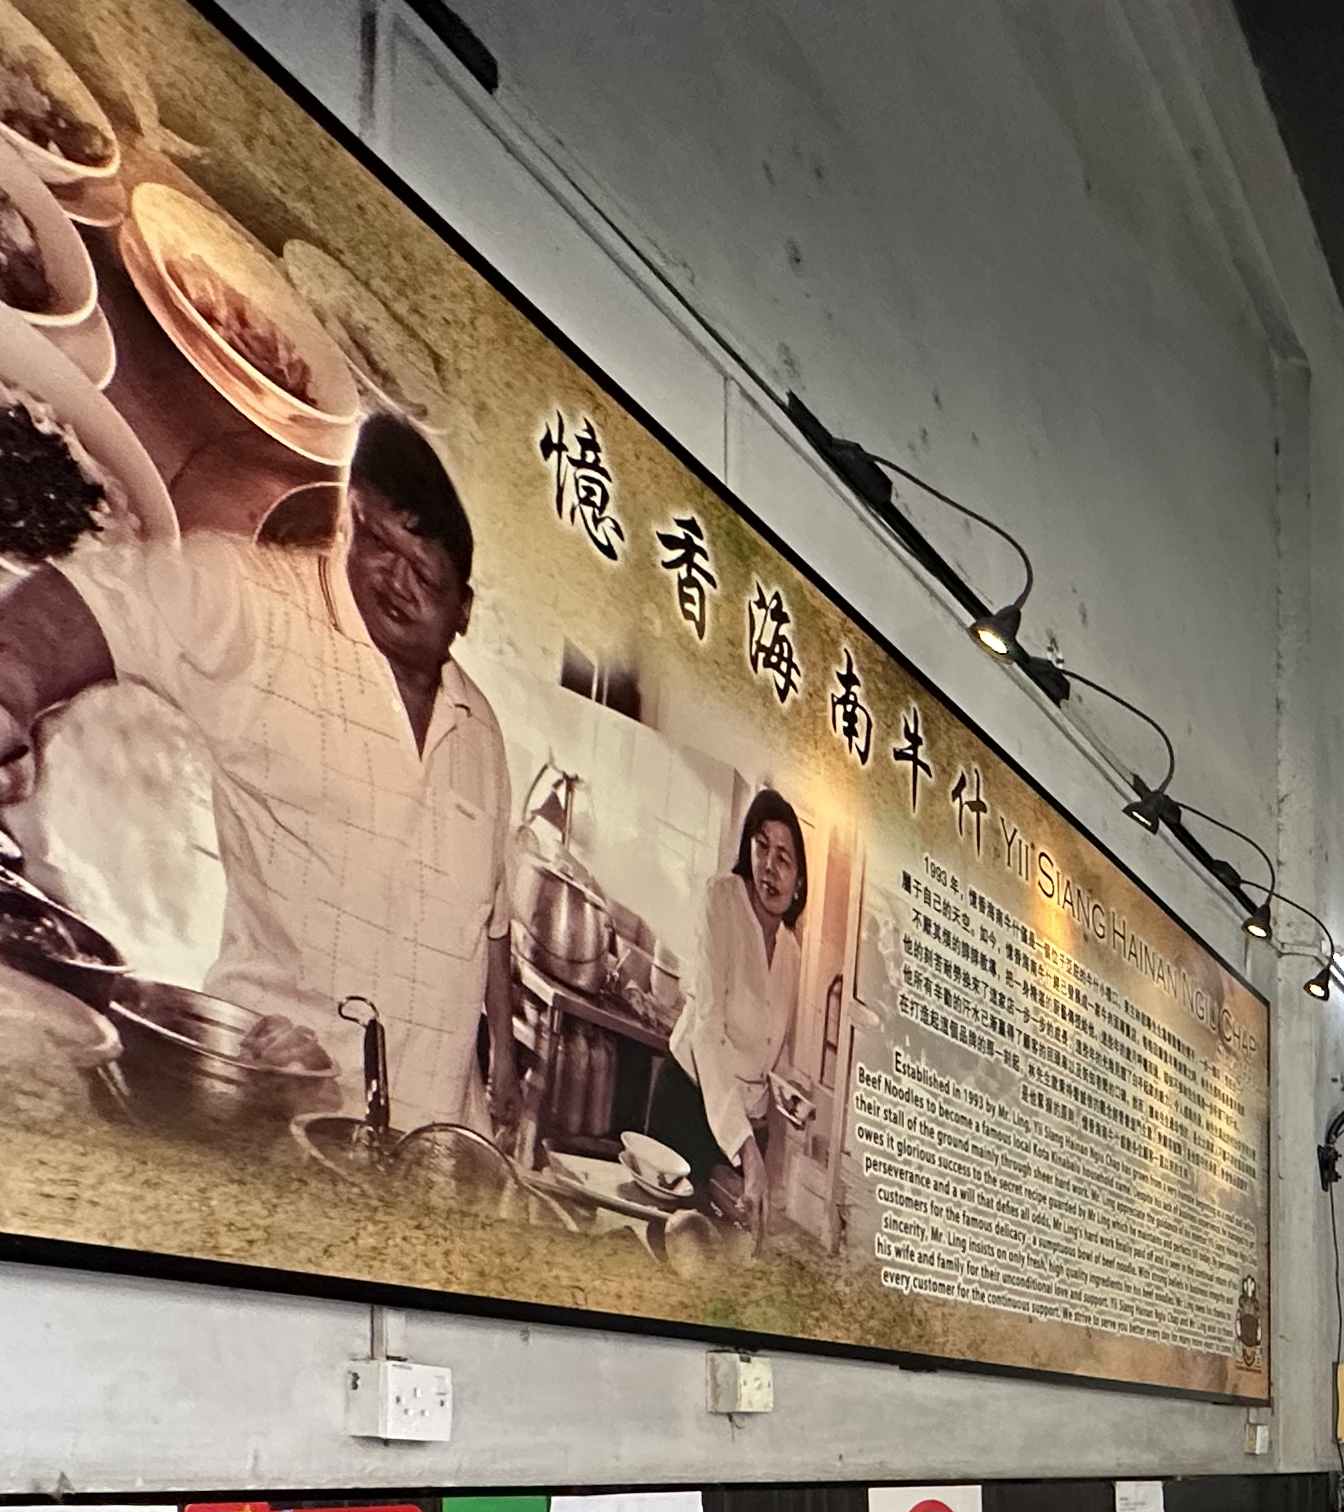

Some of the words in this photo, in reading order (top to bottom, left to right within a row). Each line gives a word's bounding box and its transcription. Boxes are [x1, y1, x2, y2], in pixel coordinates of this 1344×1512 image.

[1038, 852, 1105, 939] SIANG
[1111, 911, 1177, 999] HAINAN
[859, 1065, 881, 1091] Beef
[884, 1076, 923, 1109] Noodles
[926, 1097, 936, 1114] to
[938, 1101, 973, 1129] become
[975, 1120, 979, 1132] a
[981, 1119, 1011, 1145] famous
[1033, 1142, 1049, 1160] Kota
[895, 1050, 950, 1095] Established
[952, 1080, 960, 1099] in
[963, 1087, 983, 1109] 1993
[985, 1096, 996, 1118] by
[855, 1093, 880, 1119] their
[883, 1104, 904, 1128] stall
[907, 1114, 917, 1132] of
[919, 1118, 934, 1139] the
[936, 1126, 969, 1155] ground
[971, 1139, 999, 1167] mainly
[1000, 1151, 1031, 1179] through
[857, 1125, 883, 1145] owes
[886, 1133, 894, 1149] it
[897, 1137, 935, 1168] glorious
[938, 1155, 970, 1176] success
[972, 1166, 982, 1181] to
[983, 1169, 997, 1186] the
[998, 1176, 1023, 1196] secret
[865, 1153, 930, 1190] perseverance
[933, 1175, 950, 1195] and
[952, 1185, 957, 1197] a
[959, 1184, 974, 1203] will
[977, 1190, 994, 1209] that
[1020, 1205, 1029, 1221] all
[878, 1183, 927, 1214] customers
[930, 1200, 943, 1218] for
[945, 1204, 960, 1223] the
[962, 1209, 991, 1232] famous
[994, 1219, 1026, 1246] delicacy
[877, 1235, 891, 1256] his
[895, 1241, 915, 1262] wife
[917, 1246, 934, 1266] and
[936, 1252, 964, 1277] family
[966, 1259, 978, 1277] for
[980, 1264, 1000, 1283] their
[1001, 1269, 1053, 1296] unconditional
[947, 1231, 966, 1253] Ling
[969, 1237, 994, 1257] insists
[996, 1248, 1006, 1261] on
[883, 1269, 910, 1292] every
[912, 1275, 955, 1296] customer
[957, 1284, 969, 1299] for
[972, 1288, 985, 1302] the
